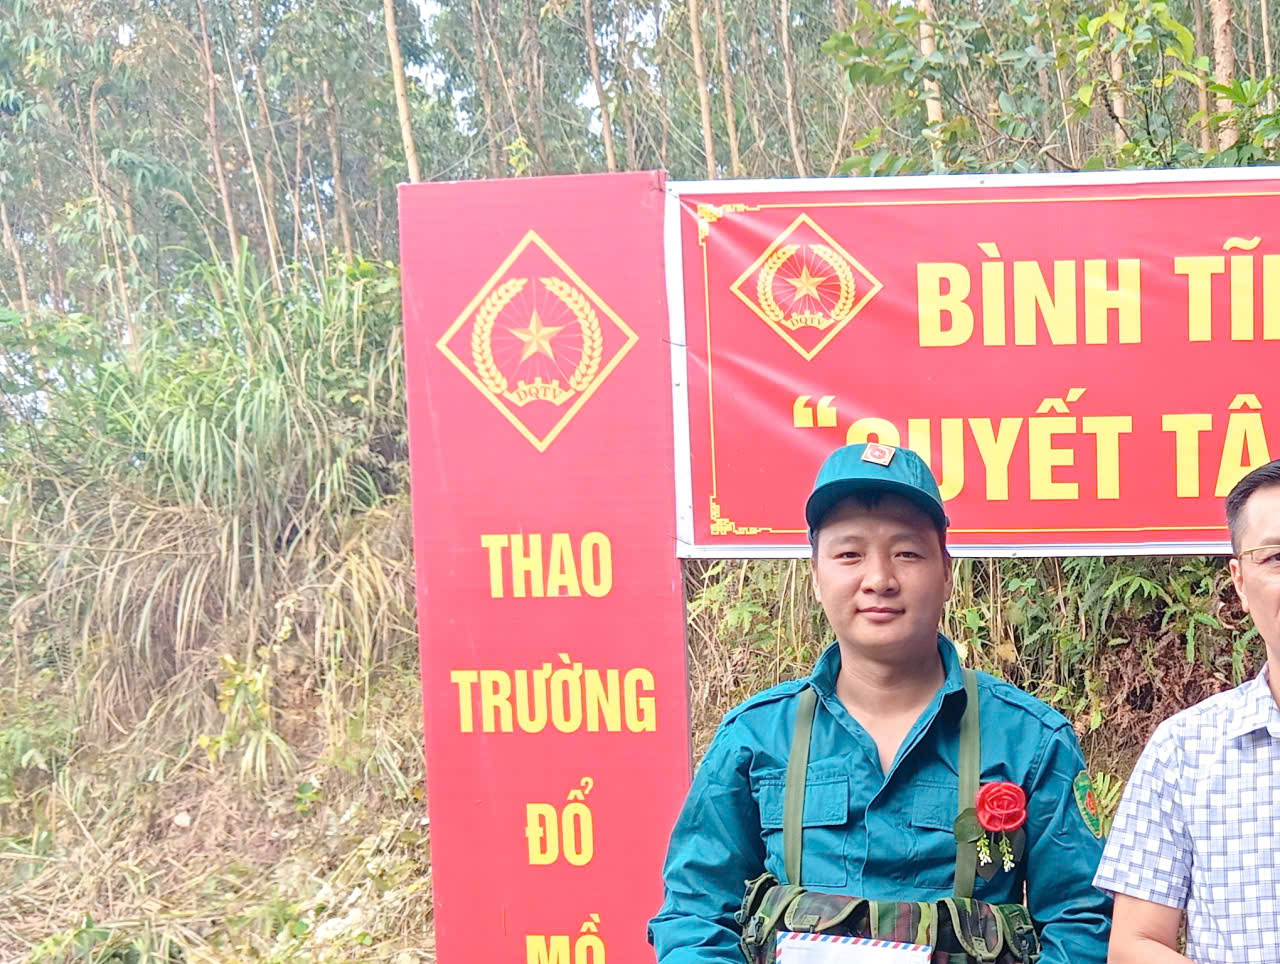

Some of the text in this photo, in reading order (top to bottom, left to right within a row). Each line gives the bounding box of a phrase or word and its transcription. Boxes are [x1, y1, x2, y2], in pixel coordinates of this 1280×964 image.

[917, 242, 1141, 347] BÌNH
[516, 386, 562, 401] DQTV
[480, 531, 613, 599] THAO
[450, 653, 657, 734] TRƯỜNG
[525, 776, 594, 866] ĐỔ
